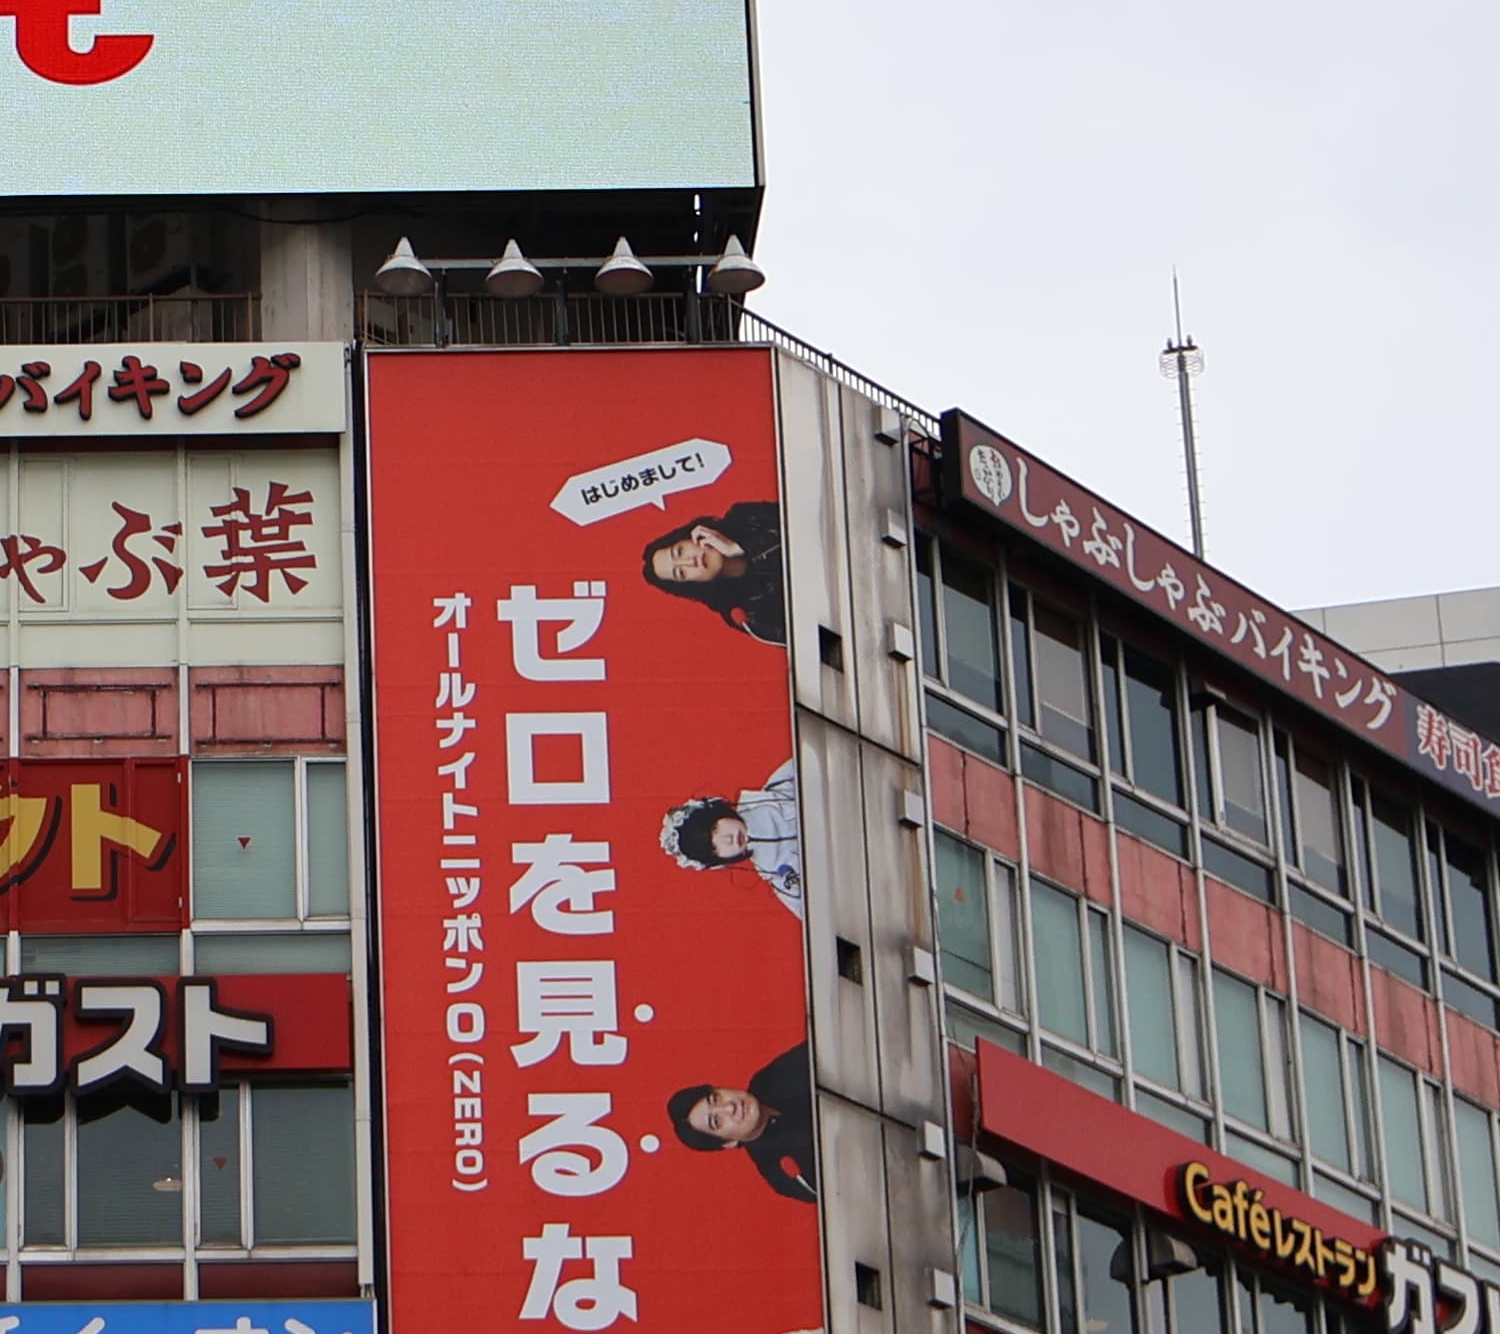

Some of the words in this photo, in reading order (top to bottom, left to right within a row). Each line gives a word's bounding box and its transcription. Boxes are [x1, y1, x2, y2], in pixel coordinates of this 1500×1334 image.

[1016, 457, 1397, 730] しゃぶしゃぶバイキング
